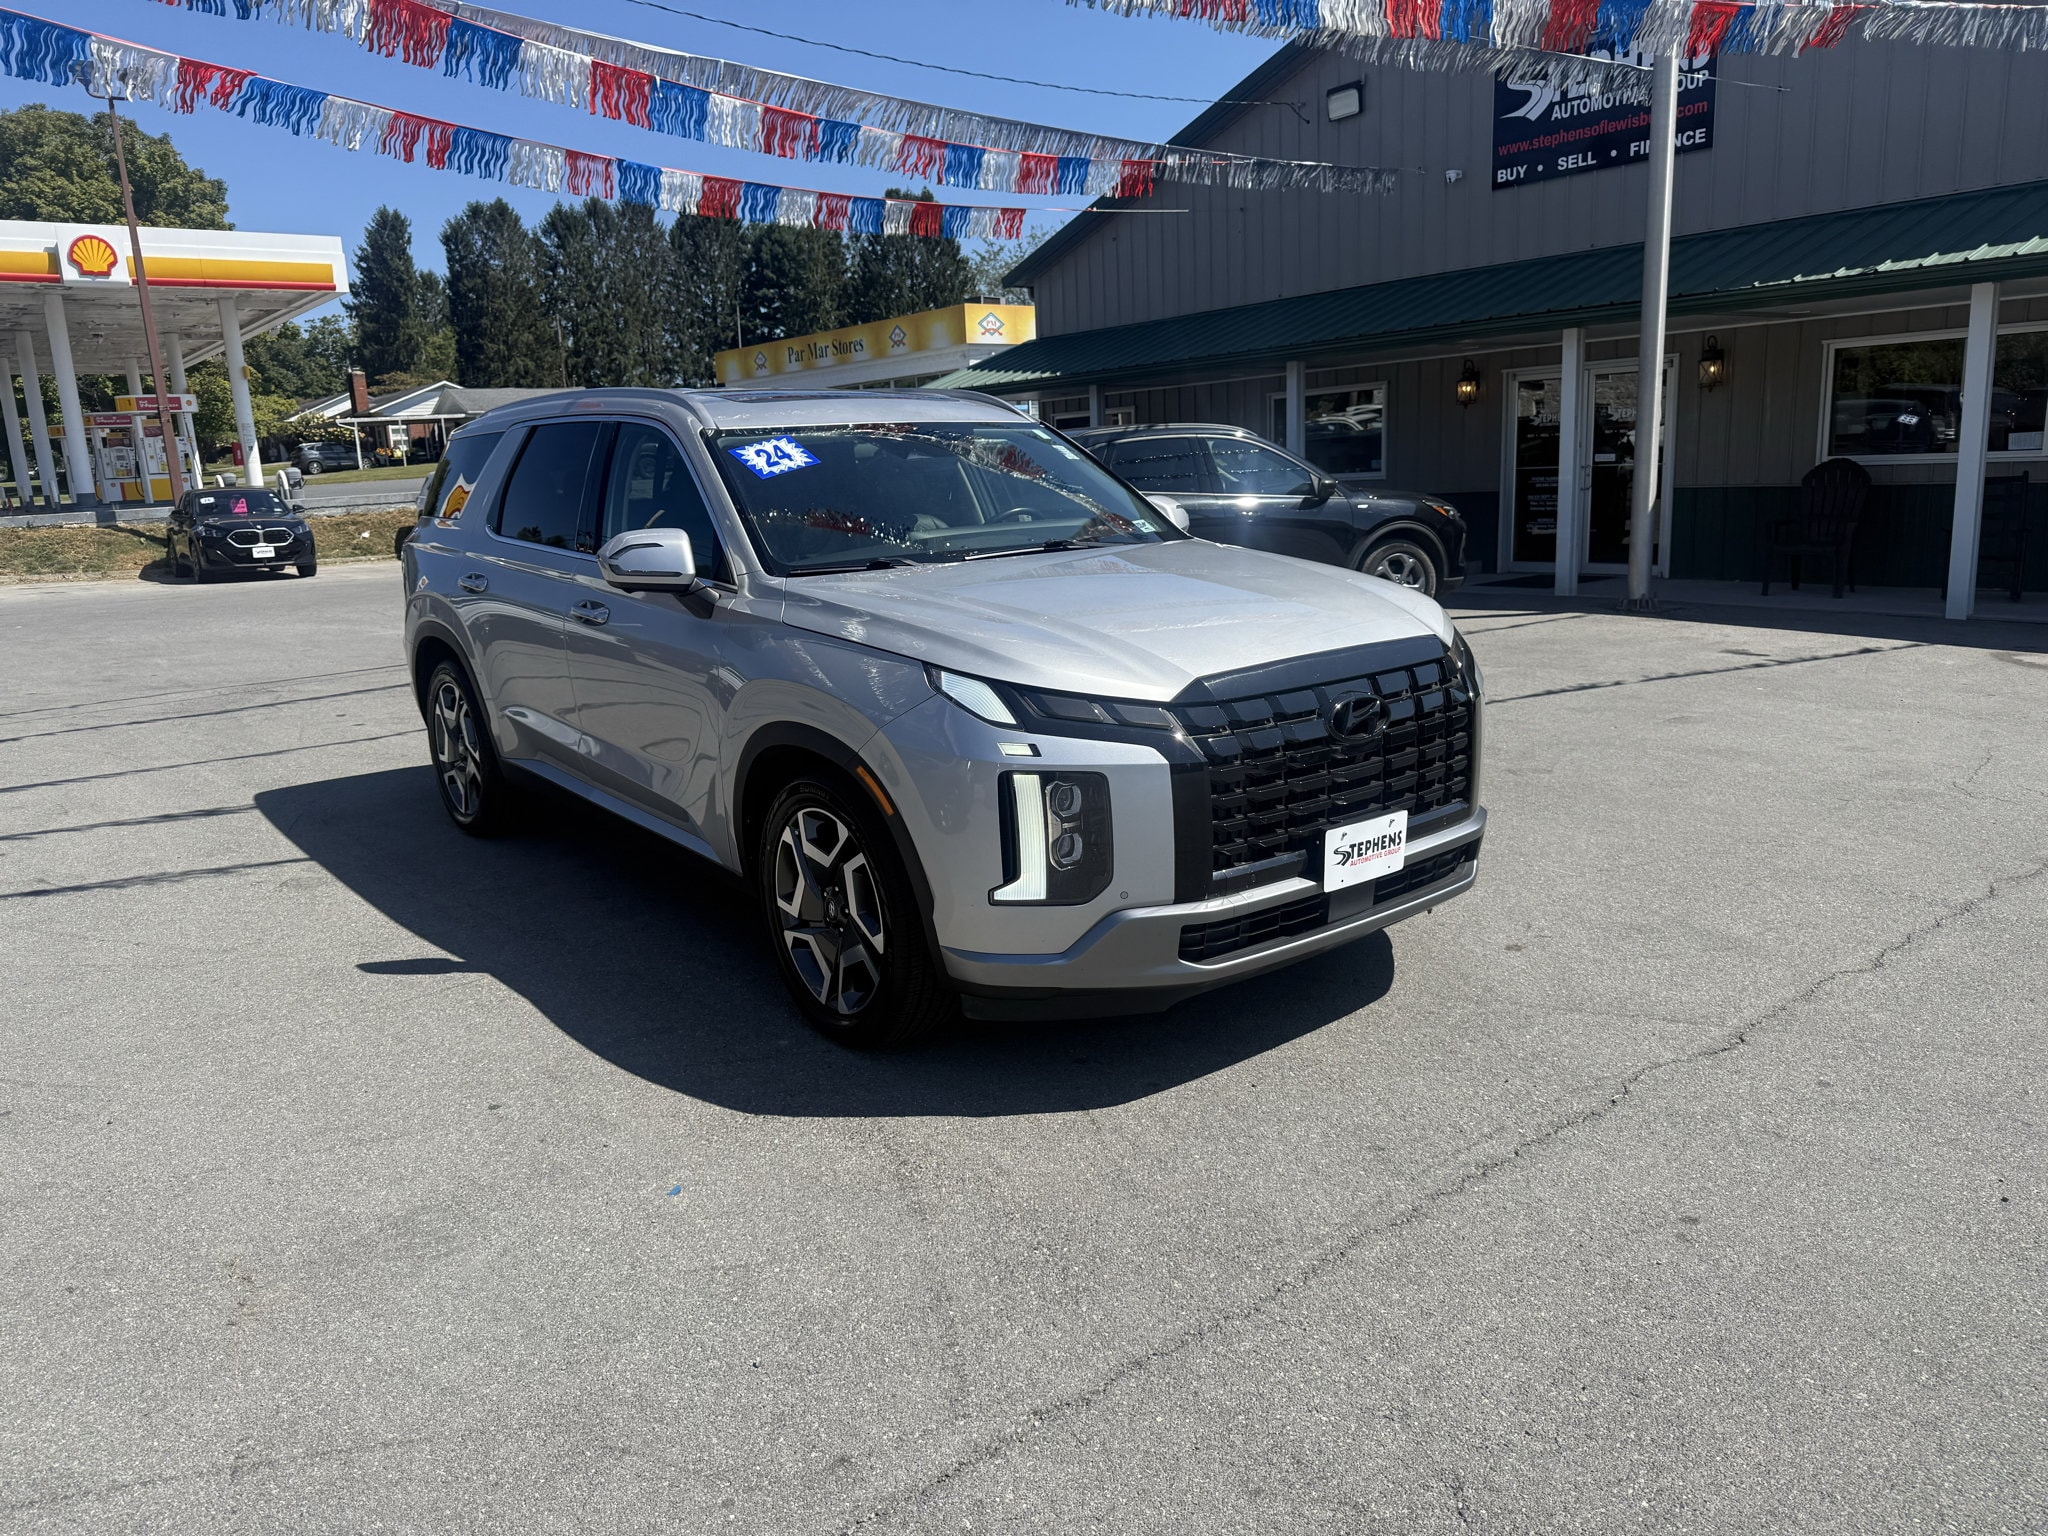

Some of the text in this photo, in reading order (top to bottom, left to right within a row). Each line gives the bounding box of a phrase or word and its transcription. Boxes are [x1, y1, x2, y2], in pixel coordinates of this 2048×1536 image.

[1497, 128, 1706, 183] BUY SELL FINCE
[787, 338, 864, 364] Par Mar Stores
[754, 445, 794, 468] 24
[1331, 830, 1402, 867] STEPHENS
[1350, 847, 1401, 867] AUTOMOTIVE GROUP
